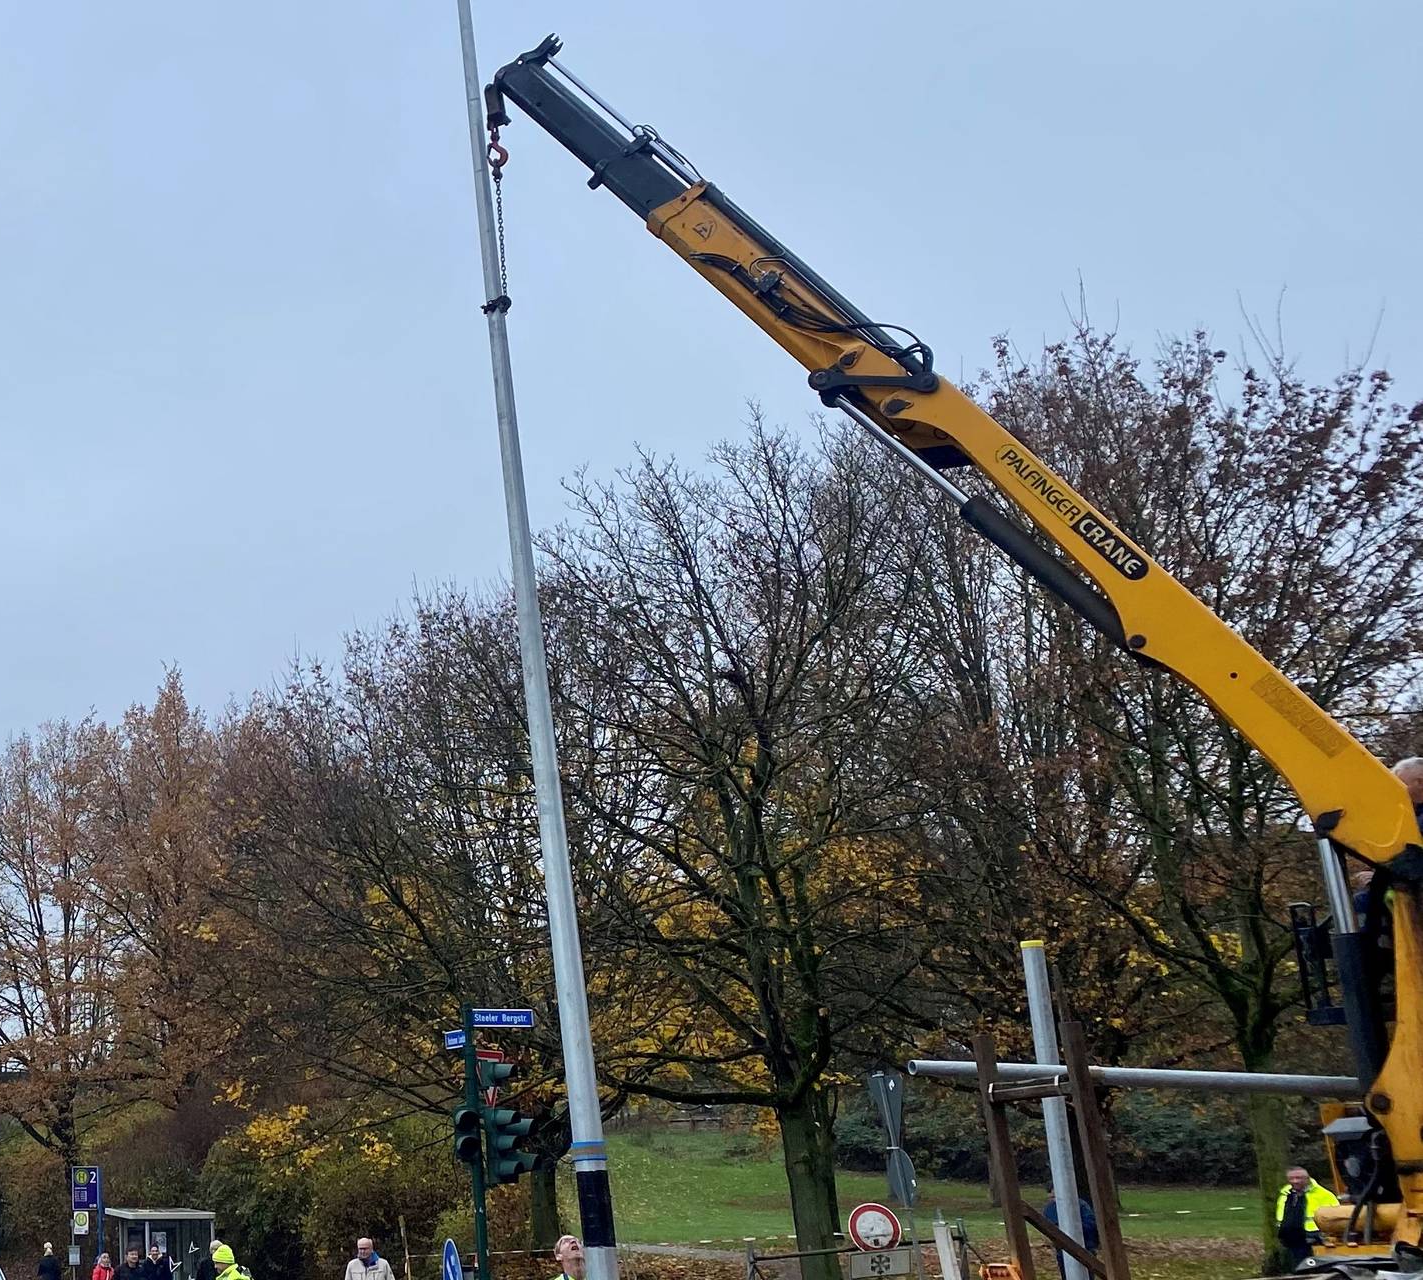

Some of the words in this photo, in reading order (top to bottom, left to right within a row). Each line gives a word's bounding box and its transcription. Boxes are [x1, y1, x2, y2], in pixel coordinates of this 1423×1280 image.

[1000, 449, 1082, 522] PALFINGER
[1079, 518, 1142, 575] CRANE
[474, 1013, 498, 1022] Steeler
[89, 1171, 97, 1183] 2
